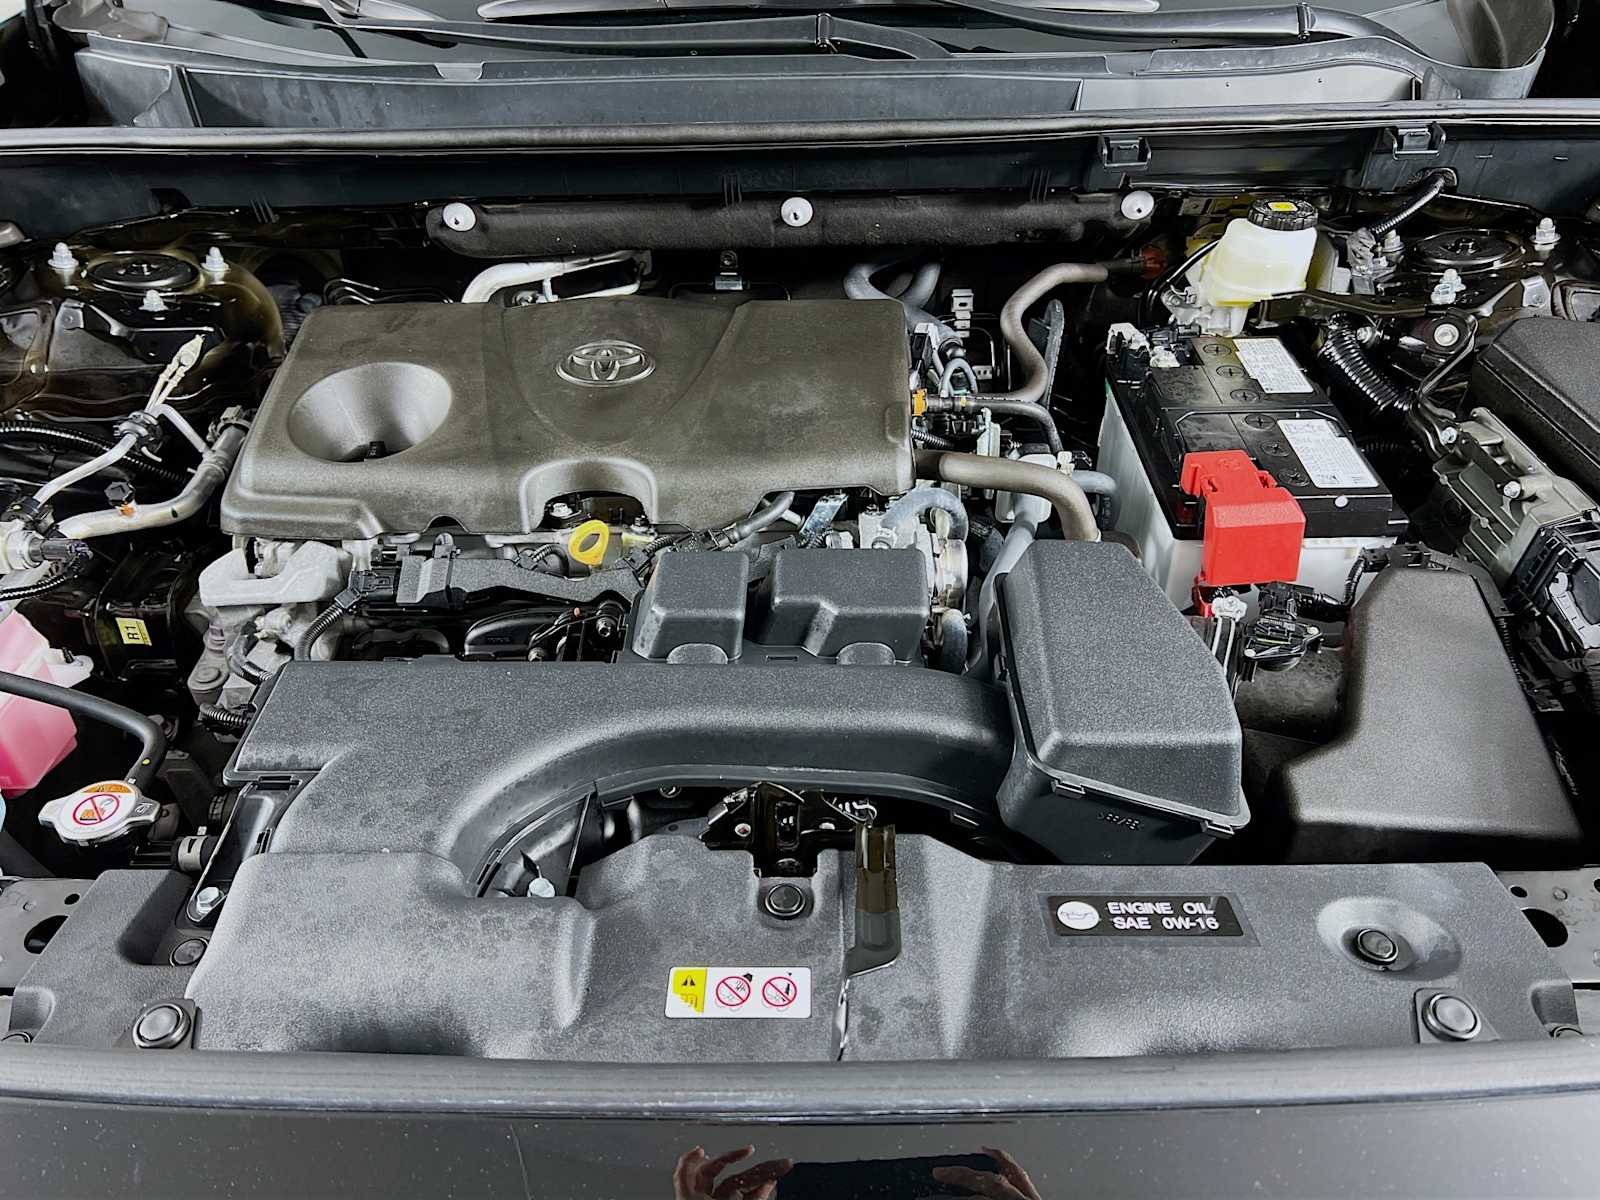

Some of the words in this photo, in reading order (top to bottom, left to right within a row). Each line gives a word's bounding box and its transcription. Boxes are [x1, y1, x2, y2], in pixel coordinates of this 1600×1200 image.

[125, 625, 140, 640] R1
[1107, 902, 1173, 914] ENGINE
[1183, 902, 1214, 914] OIL
[1112, 917, 1151, 929] SAE
[1162, 917, 1219, 930] 0W-16
